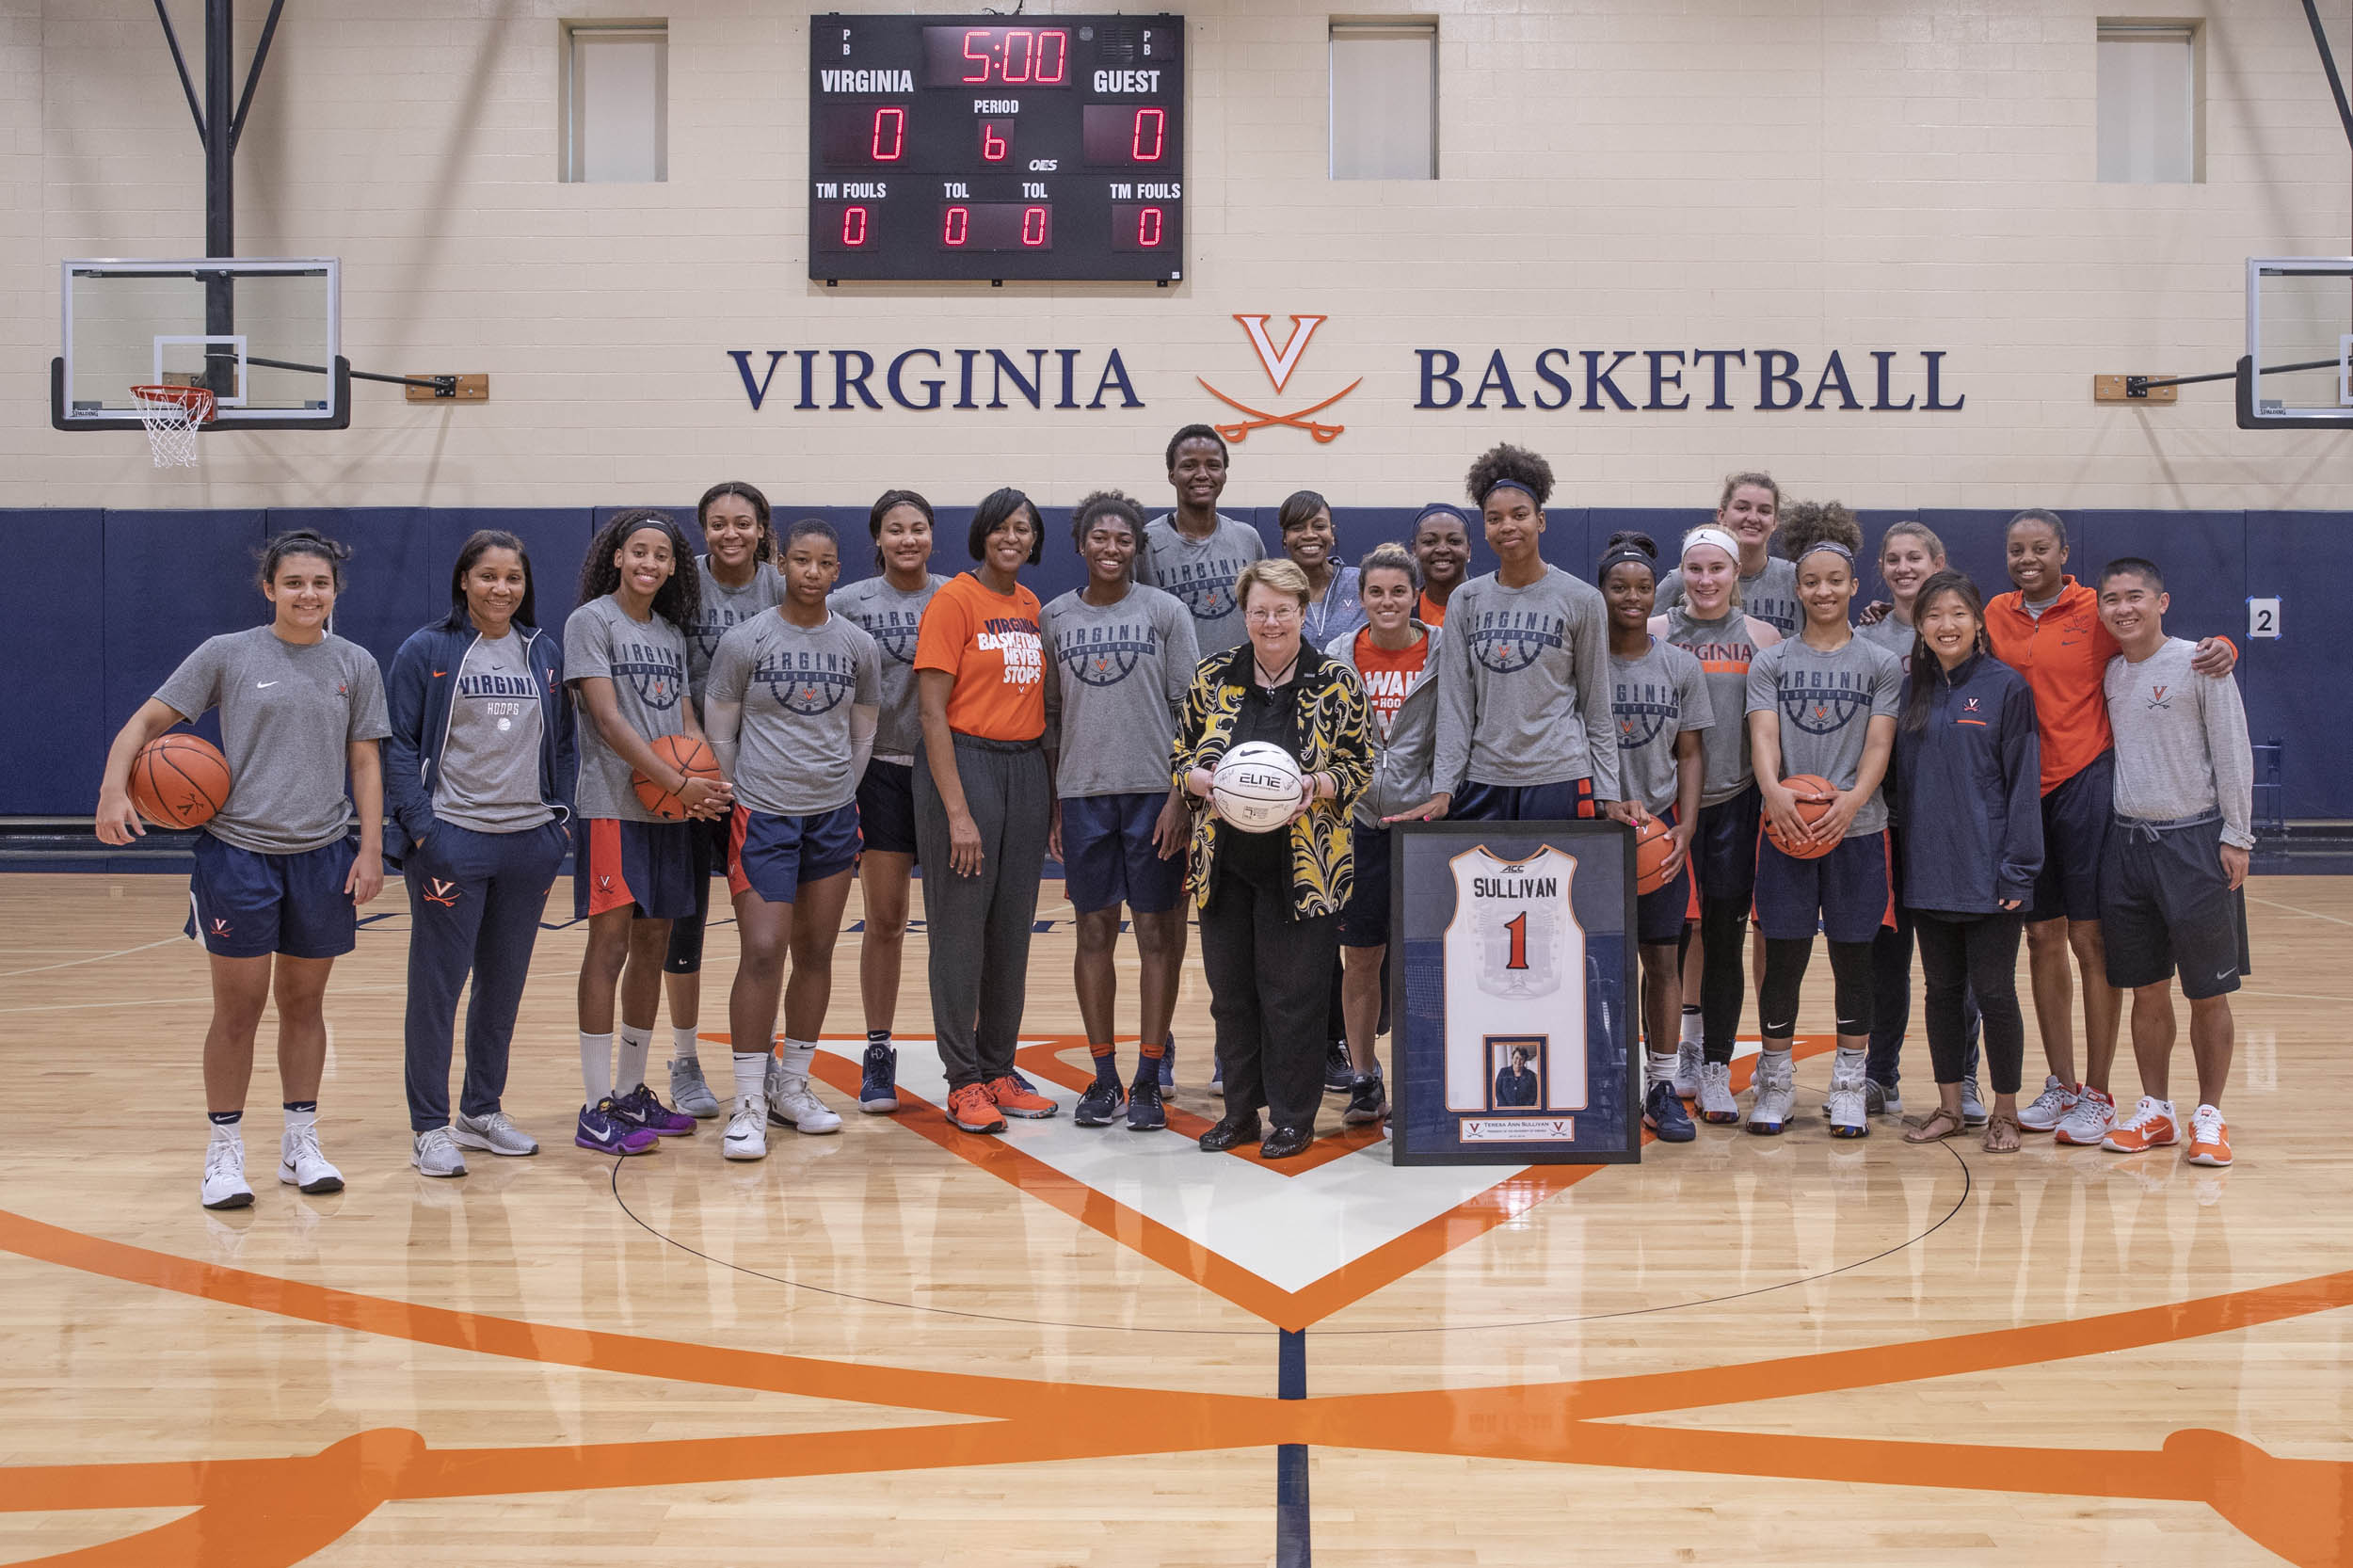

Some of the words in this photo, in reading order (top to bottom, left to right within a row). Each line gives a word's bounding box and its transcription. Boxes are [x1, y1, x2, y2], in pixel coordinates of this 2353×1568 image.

[843, 30, 851, 41] P
[1144, 30, 1151, 41] P
[843, 44, 851, 55] B
[963, 30, 1066, 83] 5:00
[1144, 44, 1151, 56] B
[821, 70, 914, 93] VIRGINIA
[1094, 71, 1160, 93] GUEST
[974, 100, 1019, 114] PERIOD
[872, 108, 904, 161] 0
[1132, 109, 1165, 161] 0
[1029, 159, 1058, 171] OES
[816, 184, 838, 199] TM
[842, 184, 887, 199] FOULS
[944, 184, 969, 199] TOL
[1022, 184, 1048, 199] TOL
[1110, 184, 1131, 199] TM
[1137, 184, 1181, 200] FOULS
[843, 207, 867, 246] 0
[945, 207, 968, 246] 0
[1022, 207, 1047, 246] 0
[1139, 207, 1161, 246] 0
[727, 347, 1145, 410] VIRGINIA
[1414, 348, 1965, 411] BASKETBALL
[862, 612, 917, 630] VIRG
[984, 617, 1040, 634] VIRGINIA
[1467, 612, 1564, 637] IRGINIA
[2257, 610, 2272, 631] 2
[977, 632, 1043, 650] BASKETBA
[1002, 648, 1042, 666] NEVER
[1003, 665, 1041, 684] STOPS
[459, 675, 538, 695] VIRGINI
[1616, 684, 1679, 706] GINIA
[488, 702, 520, 715] HOOPS
[1240, 773, 1281, 788] ELITE
[1500, 865, 1525, 873] ACC
[1474, 878, 1557, 898] SULLIVAN
[1504, 910, 1529, 969] 1
